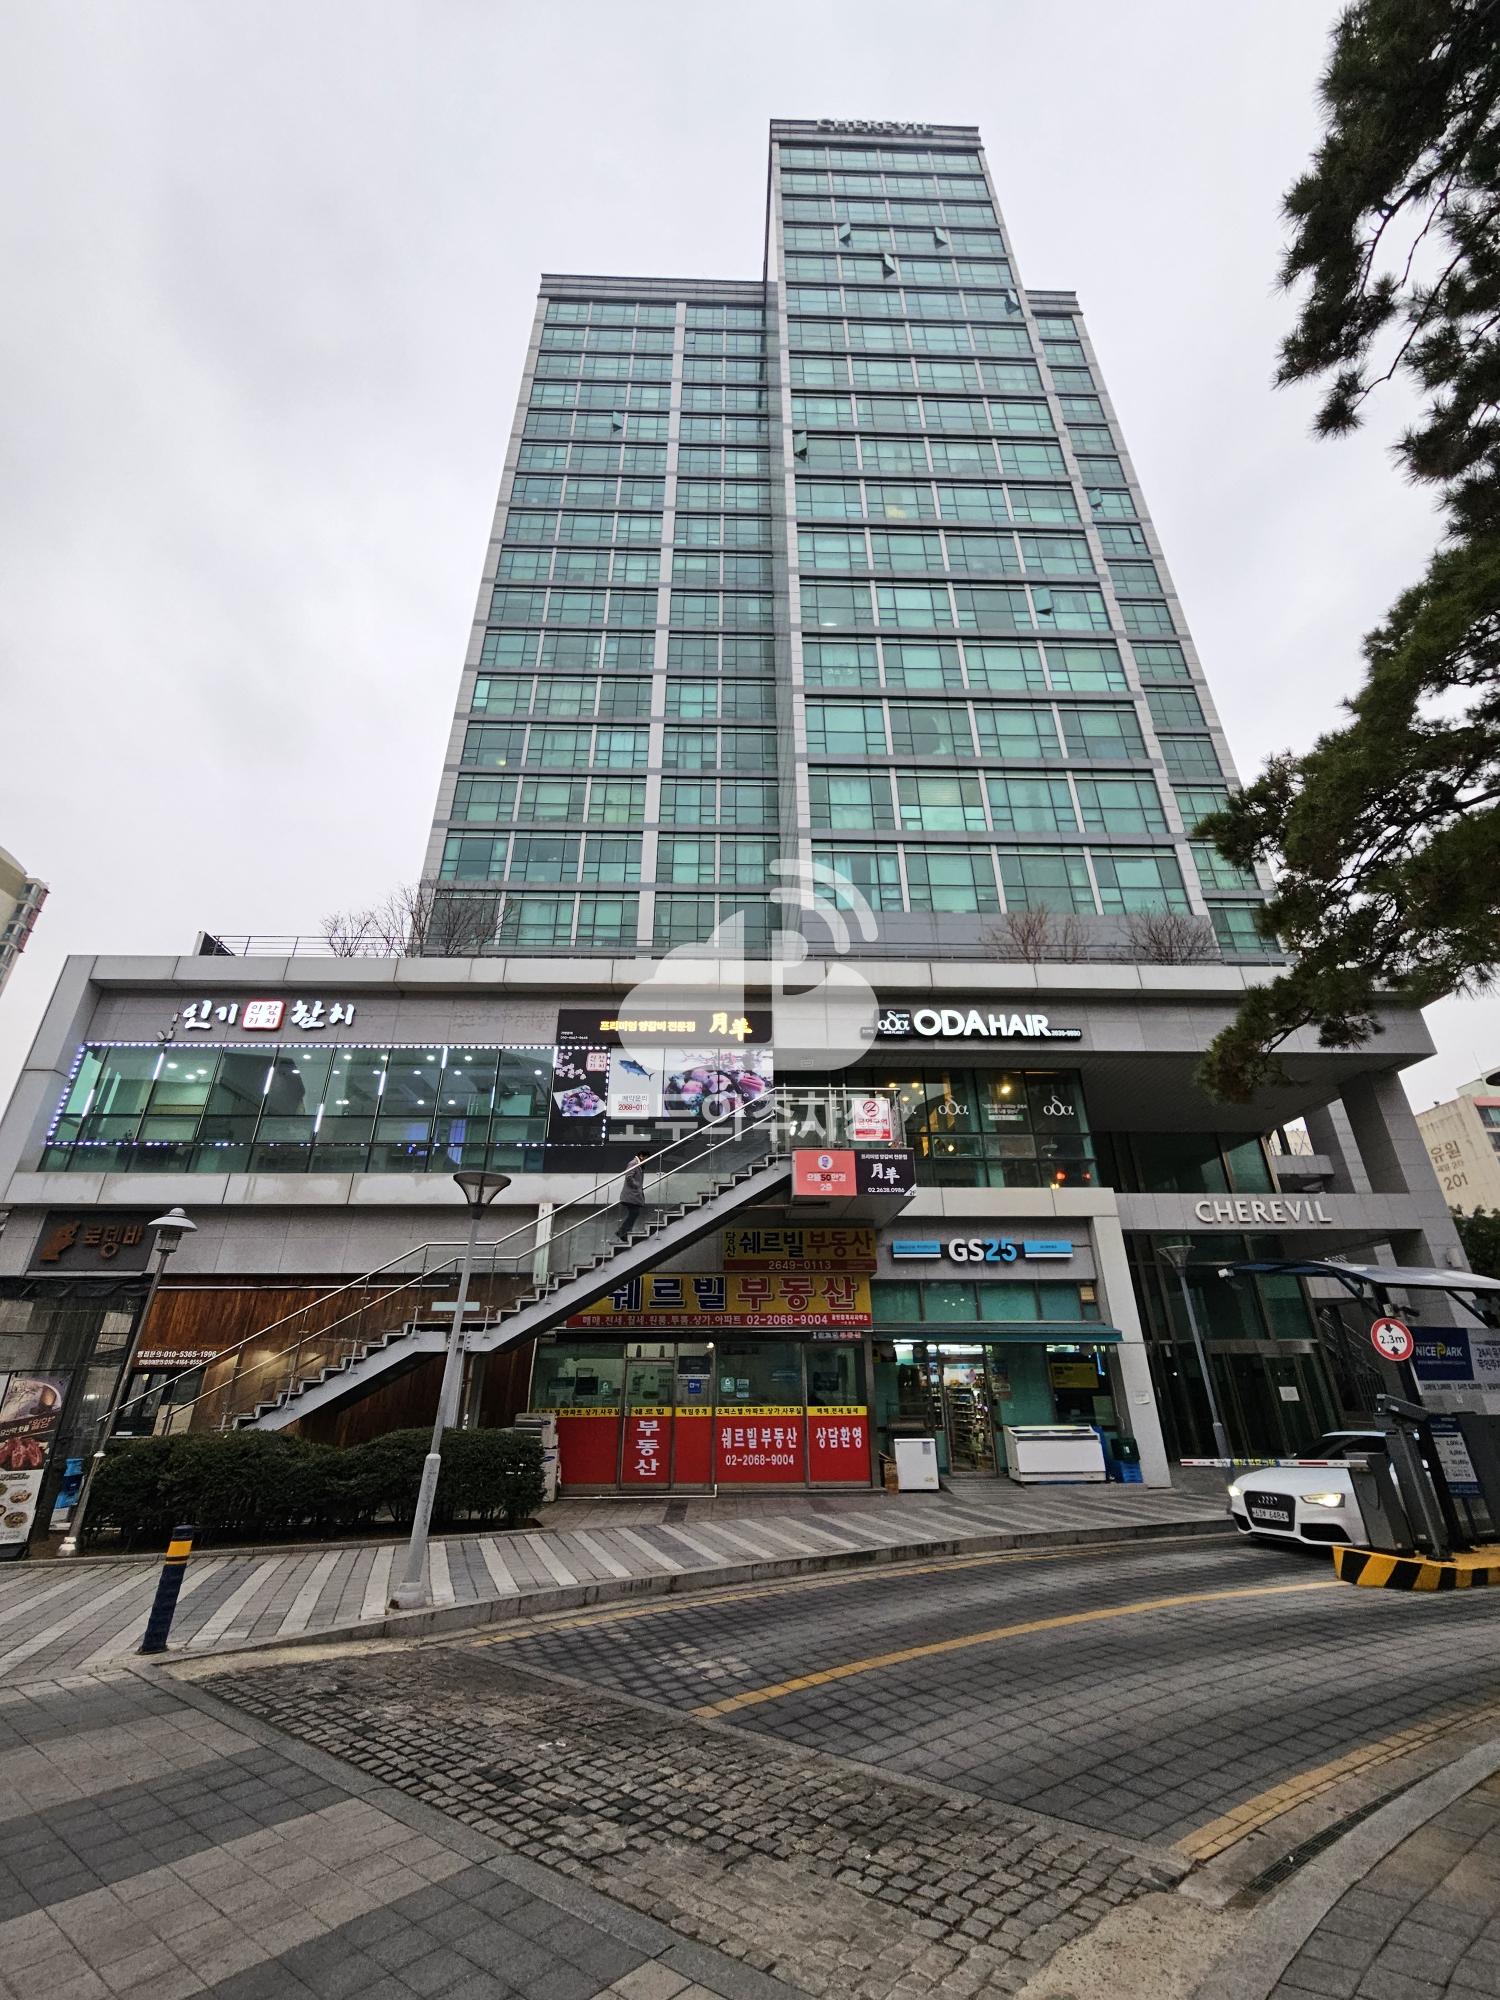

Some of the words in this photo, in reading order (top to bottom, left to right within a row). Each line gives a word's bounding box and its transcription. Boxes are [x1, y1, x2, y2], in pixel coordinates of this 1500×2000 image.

[817, 118, 932, 132] CHEREVIL
[182, 1000, 239, 1029] 인기
[290, 1000, 355, 1030] 참치
[600, 1020, 638, 1032] 프리미엄
[667, 1020, 696, 1032] 전문점
[913, 1009, 989, 1036] ODA
[988, 1014, 1050, 1037] HAIR
[1430, 1141, 1461, 1163] 유원
[1444, 1171, 1468, 1190] 201
[1194, 1200, 1333, 1223] CHEREVIL
[82, 1225, 144, 1258] 로뎅바
[725, 1231, 736, 1258] 당산
[739, 1231, 804, 1258] 쉐르빌
[806, 1231, 873, 1258] 부동산
[949, 1238, 1018, 1262] GS25
[768, 1260, 832, 1270] 2649-0113
[736, 1276, 859, 1311] 부동산
[746, 1314, 828, 1325] 02-2068-9004
[1379, 1334, 1405, 1345] 2.3m
[634, 1420, 660, 1476] 부동산
[721, 1427, 757, 1449] 쉐르빌
[760, 1427, 798, 1449] 부동산
[815, 1427, 862, 1449] 상담환영
[725, 1454, 794, 1466] 02-2068-9004
